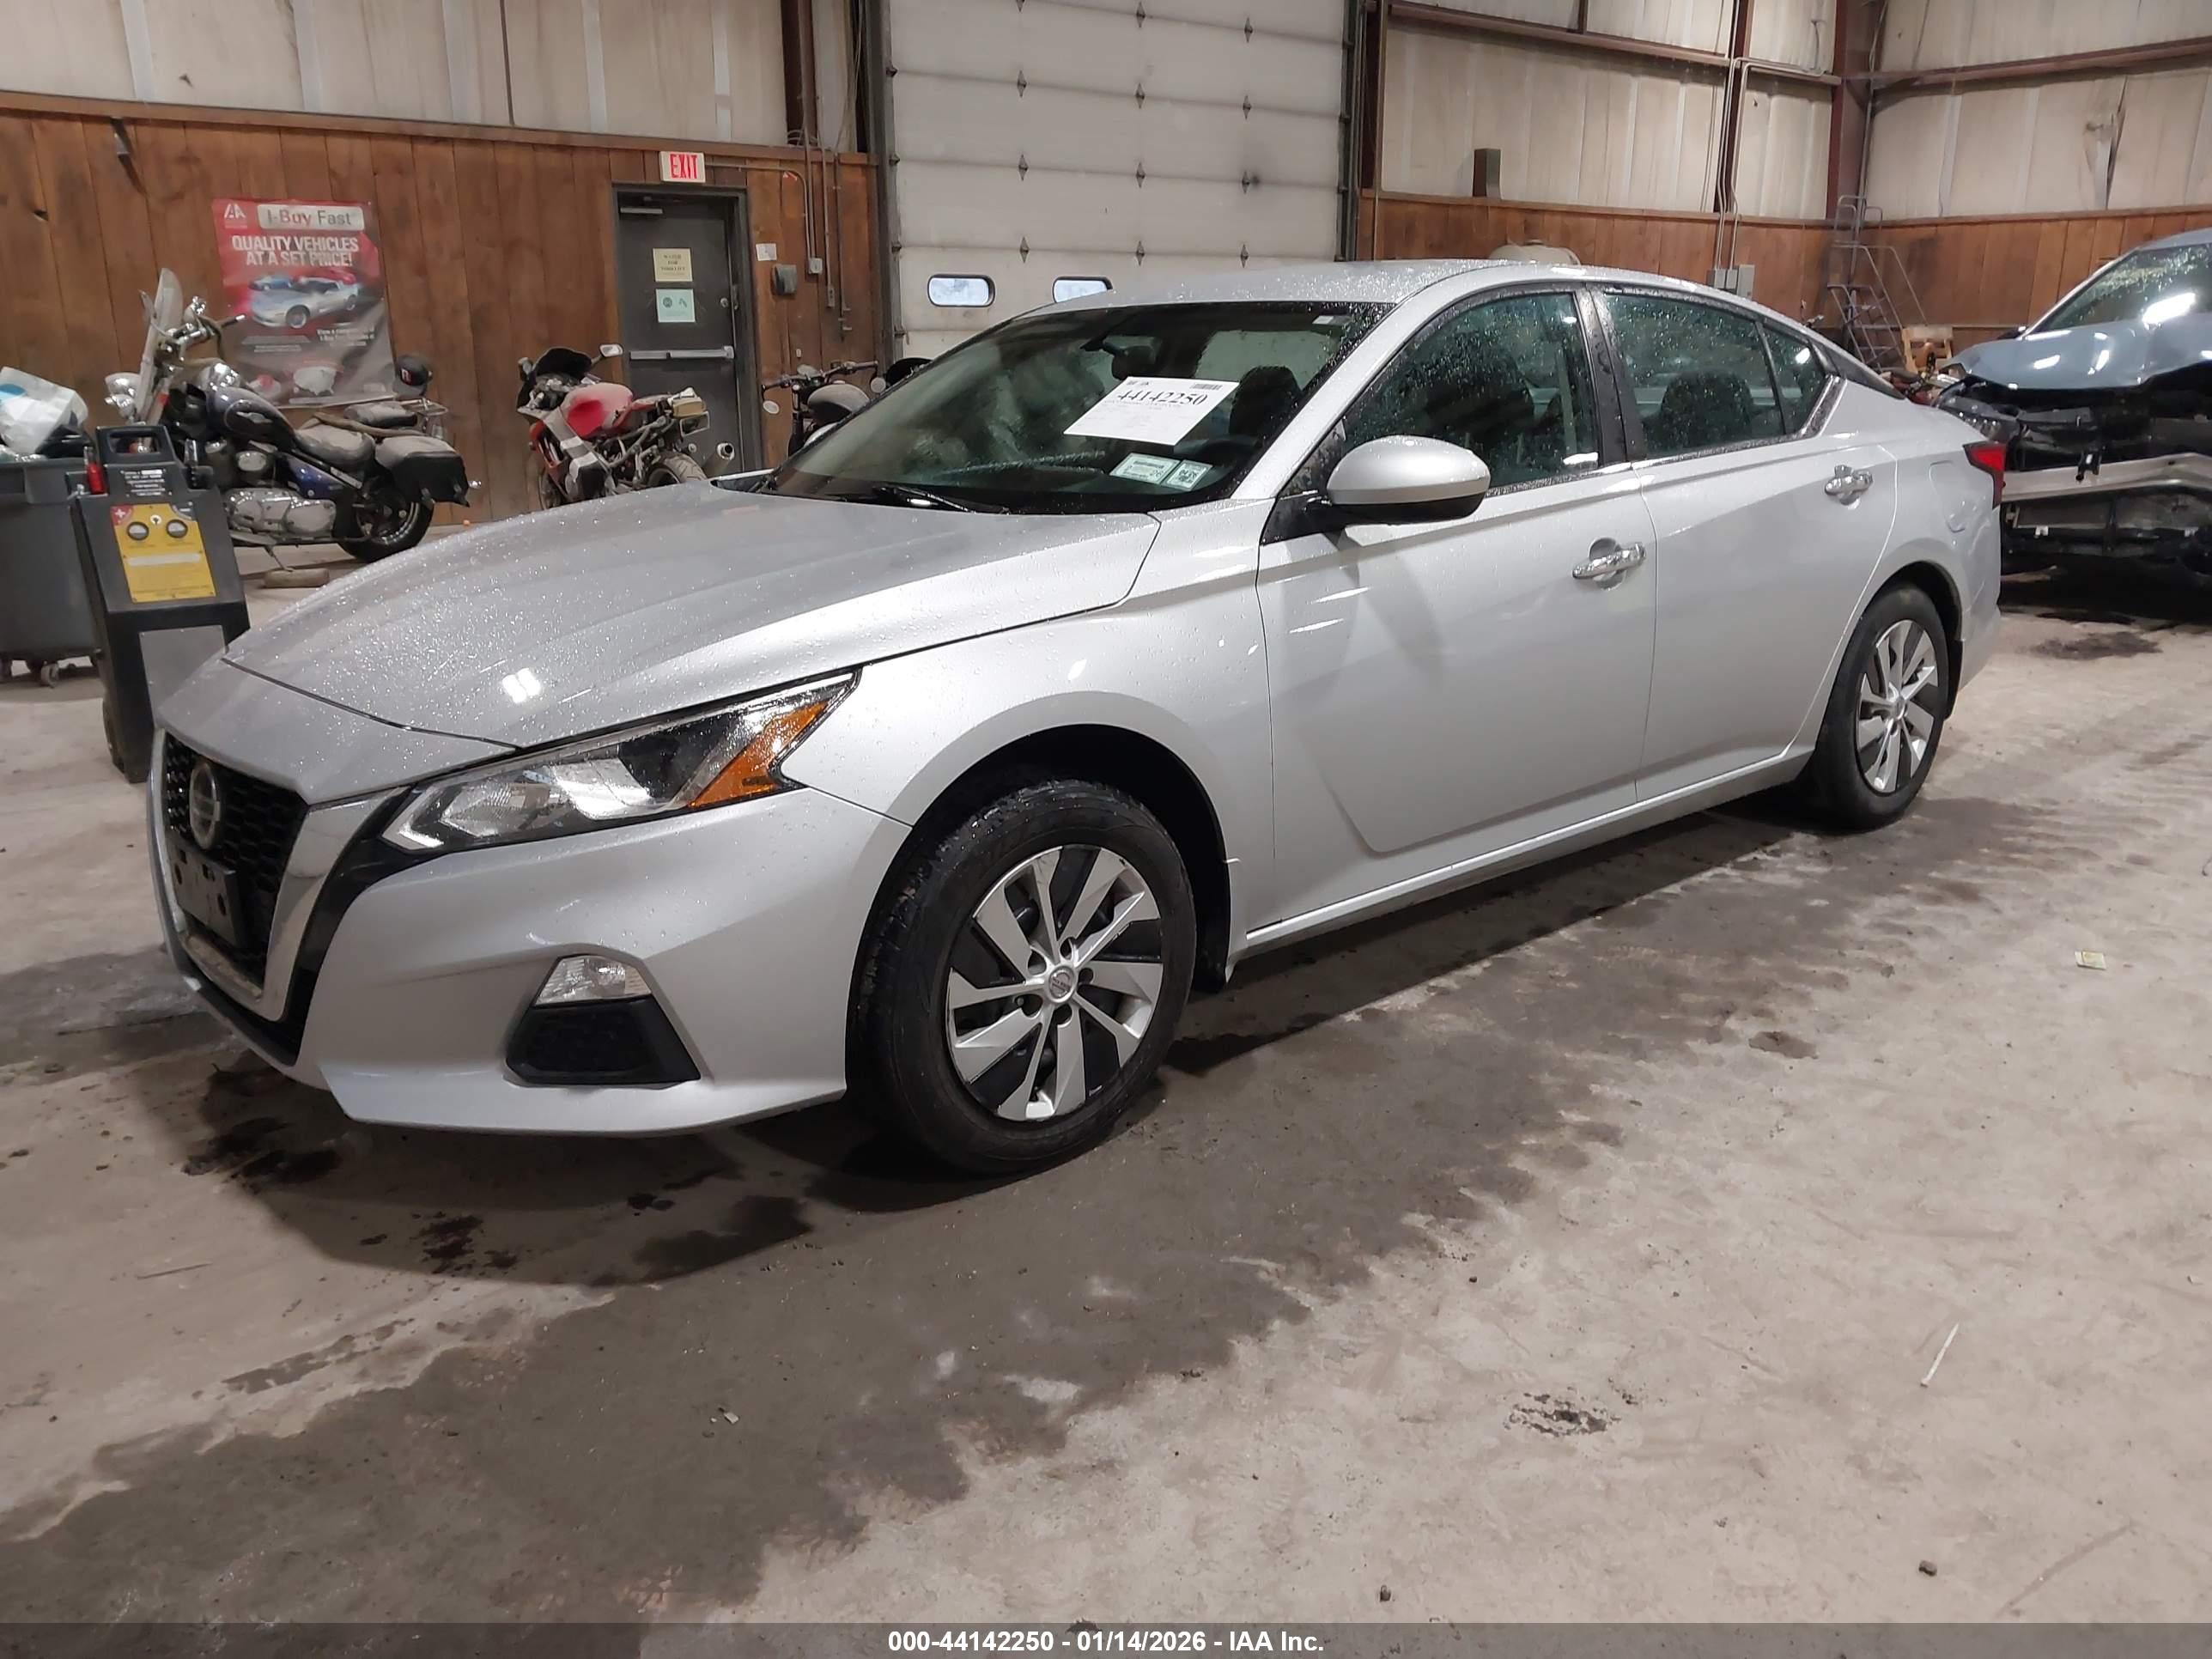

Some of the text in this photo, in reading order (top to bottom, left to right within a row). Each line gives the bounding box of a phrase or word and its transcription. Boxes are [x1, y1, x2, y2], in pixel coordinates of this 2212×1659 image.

[670, 153, 697, 179] EXIT
[267, 209, 352, 226] I-Buy Fast
[232, 234, 359, 252] QUALITY VEHICLES
[246, 251, 267, 265] AT
[267, 251, 280, 265] A
[280, 251, 307, 265] SET
[1117, 390, 1208, 406] 44142250
